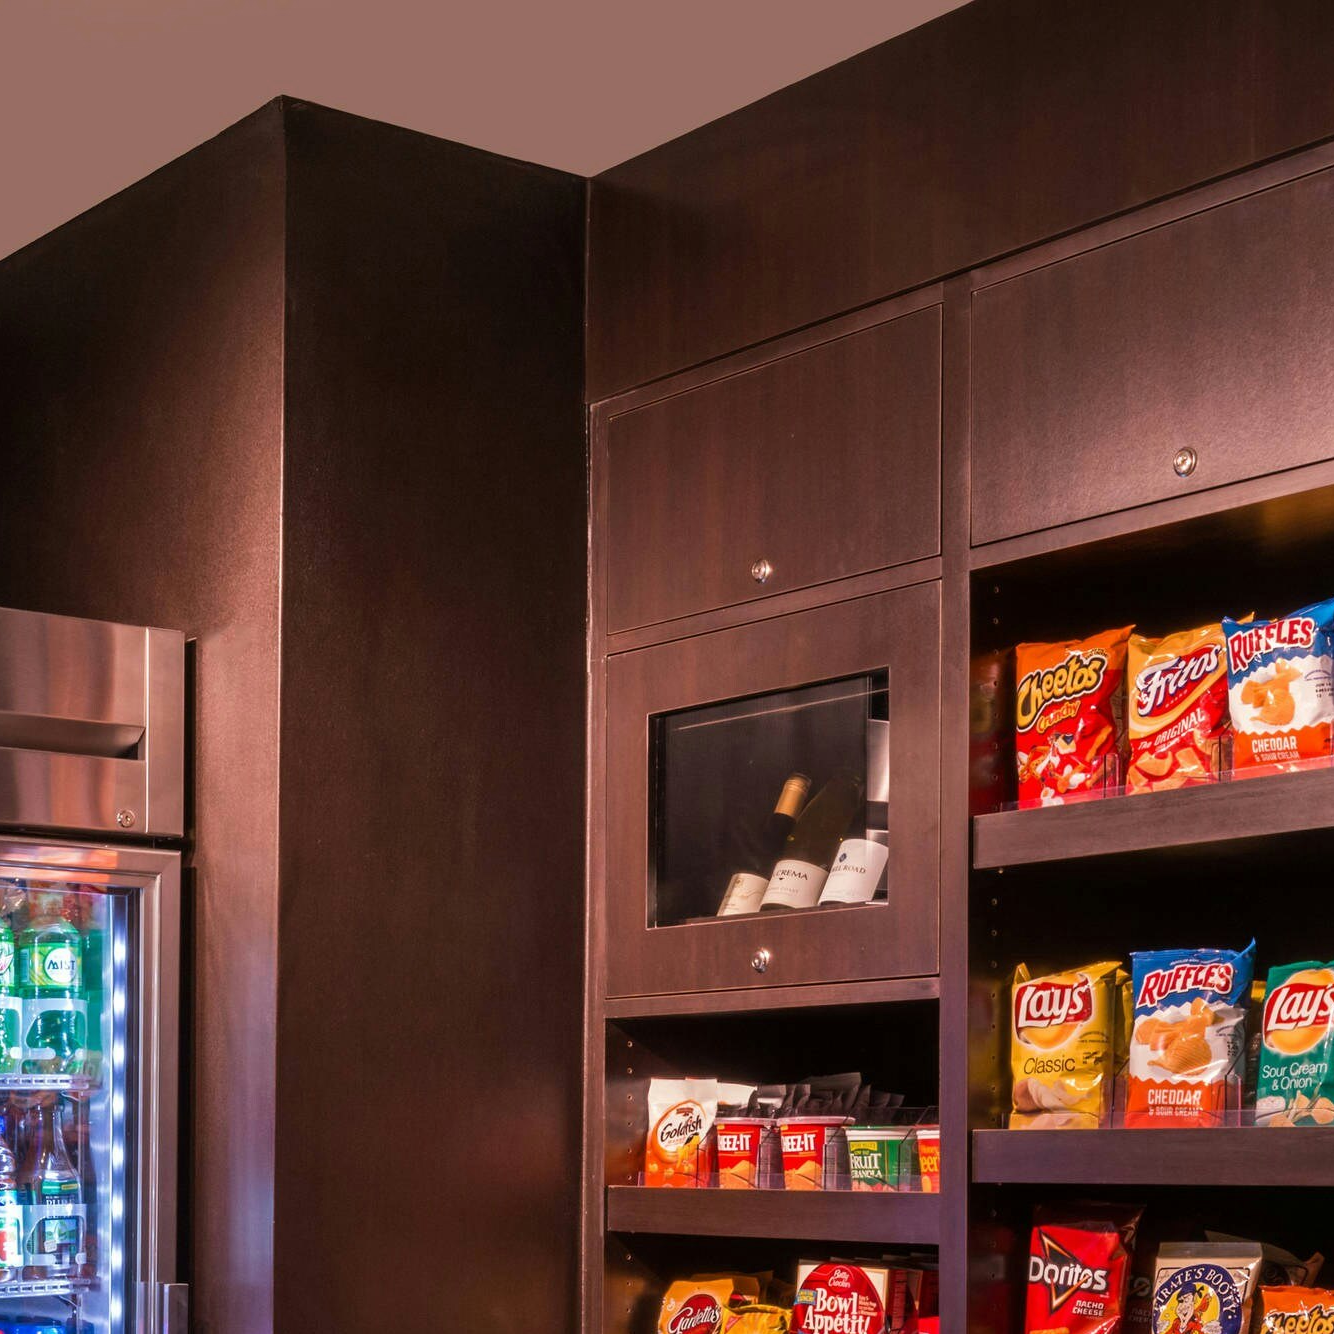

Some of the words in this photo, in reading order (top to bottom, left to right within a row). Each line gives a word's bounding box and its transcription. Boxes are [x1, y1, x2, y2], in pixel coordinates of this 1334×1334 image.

[1228, 617, 1315, 674] RUFFLES
[1135, 644, 1224, 717] Fritos
[1017, 654, 1109, 732] Cheetos
[1036, 700, 1081, 734] Crunchy
[1154, 708, 1206, 746] ORIGINAL
[1251, 736, 1298, 754] CHEDDAR
[46, 959, 77, 971] MIST
[1135, 962, 1234, 1009] RUFFLES
[1017, 983, 1091, 1029] Lay's
[1023, 1055, 1077, 1076] Classic
[1262, 1064, 1286, 1079] Sour
[1289, 1062, 1328, 1076] Cream
[1280, 1077, 1313, 1090] Onion
[1147, 1088, 1203, 1106] CHEDDAR
[1156, 1106, 1174, 1117] SOUR
[1175, 1106, 1200, 1117] CREAM
[660, 1115, 703, 1142] Goldfish
[718, 1134, 752, 1152] HEEZ-IT
[781, 1133, 816, 1152] HEEZ-IT
[849, 1152, 882, 1169] FRUIT
[833, 1269, 850, 1281] Betty
[1029, 1255, 1110, 1292] Doritos
[1153, 1266, 1204, 1313] PIRATE'S
[1204, 1267, 1238, 1315] BOOTY
[814, 1287, 859, 1315] Bowl
[1075, 1299, 1105, 1311] NACHO
[1072, 1307, 1105, 1318] CHEESE
